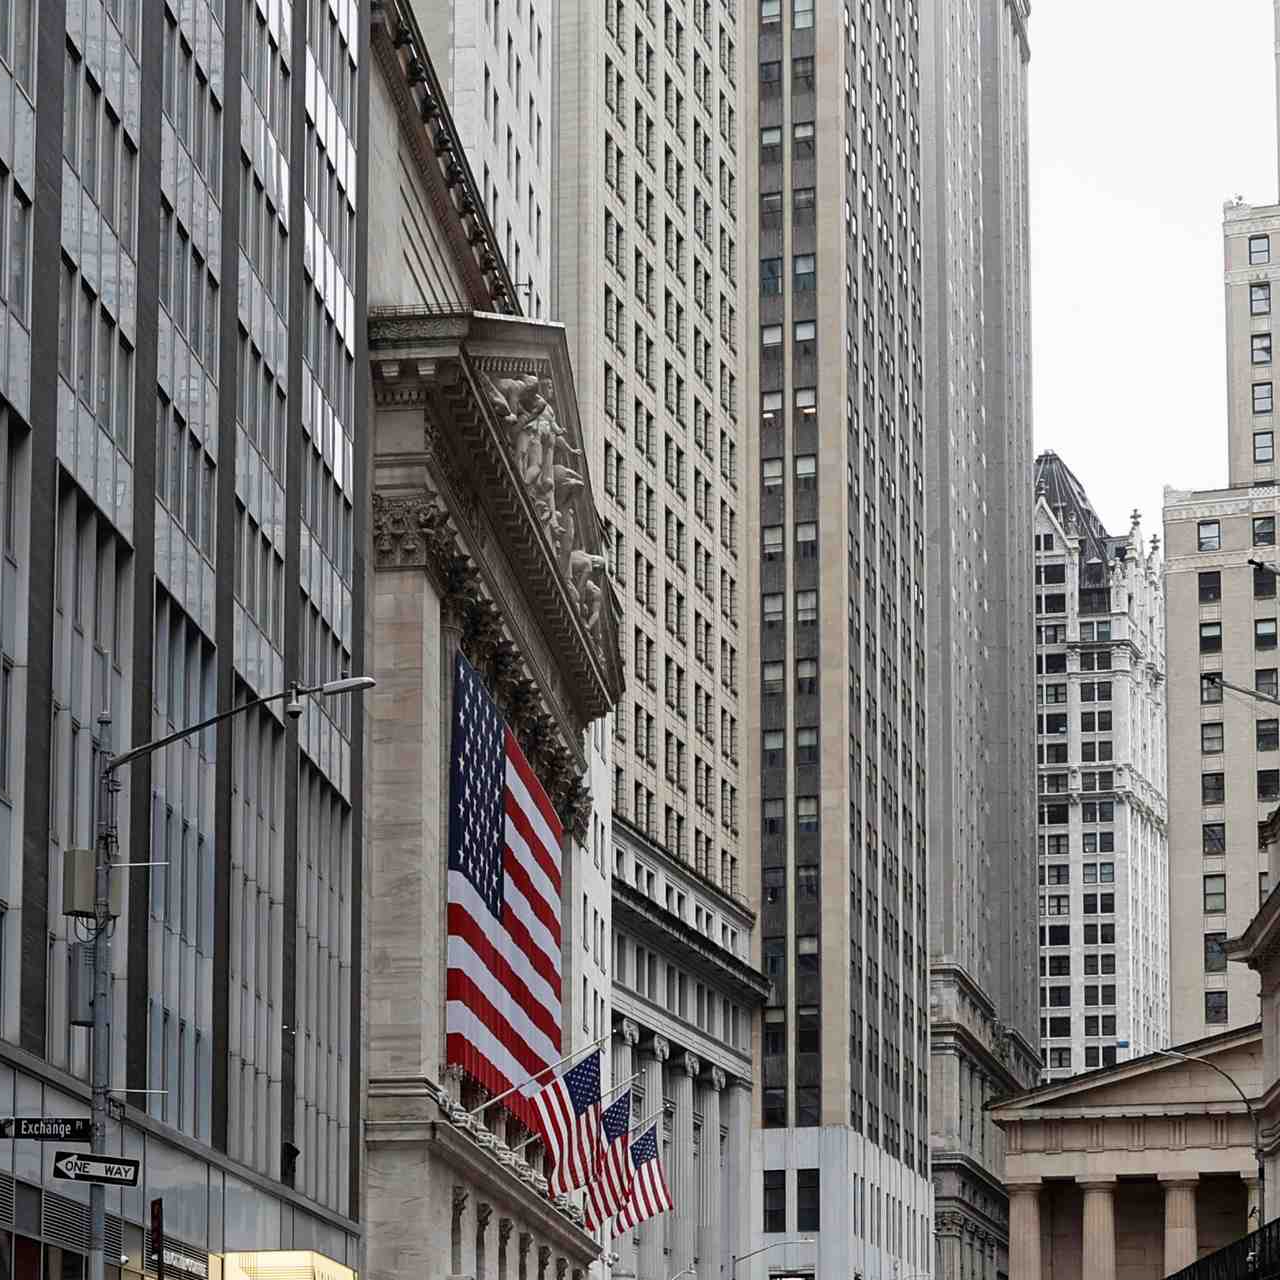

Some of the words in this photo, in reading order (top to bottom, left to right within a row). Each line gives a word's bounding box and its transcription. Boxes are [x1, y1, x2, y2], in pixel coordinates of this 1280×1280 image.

[20, 1120, 72, 1138] Exchange
[65, 1160, 91, 1174] ONE
[104, 1165, 132, 1178] WAY
